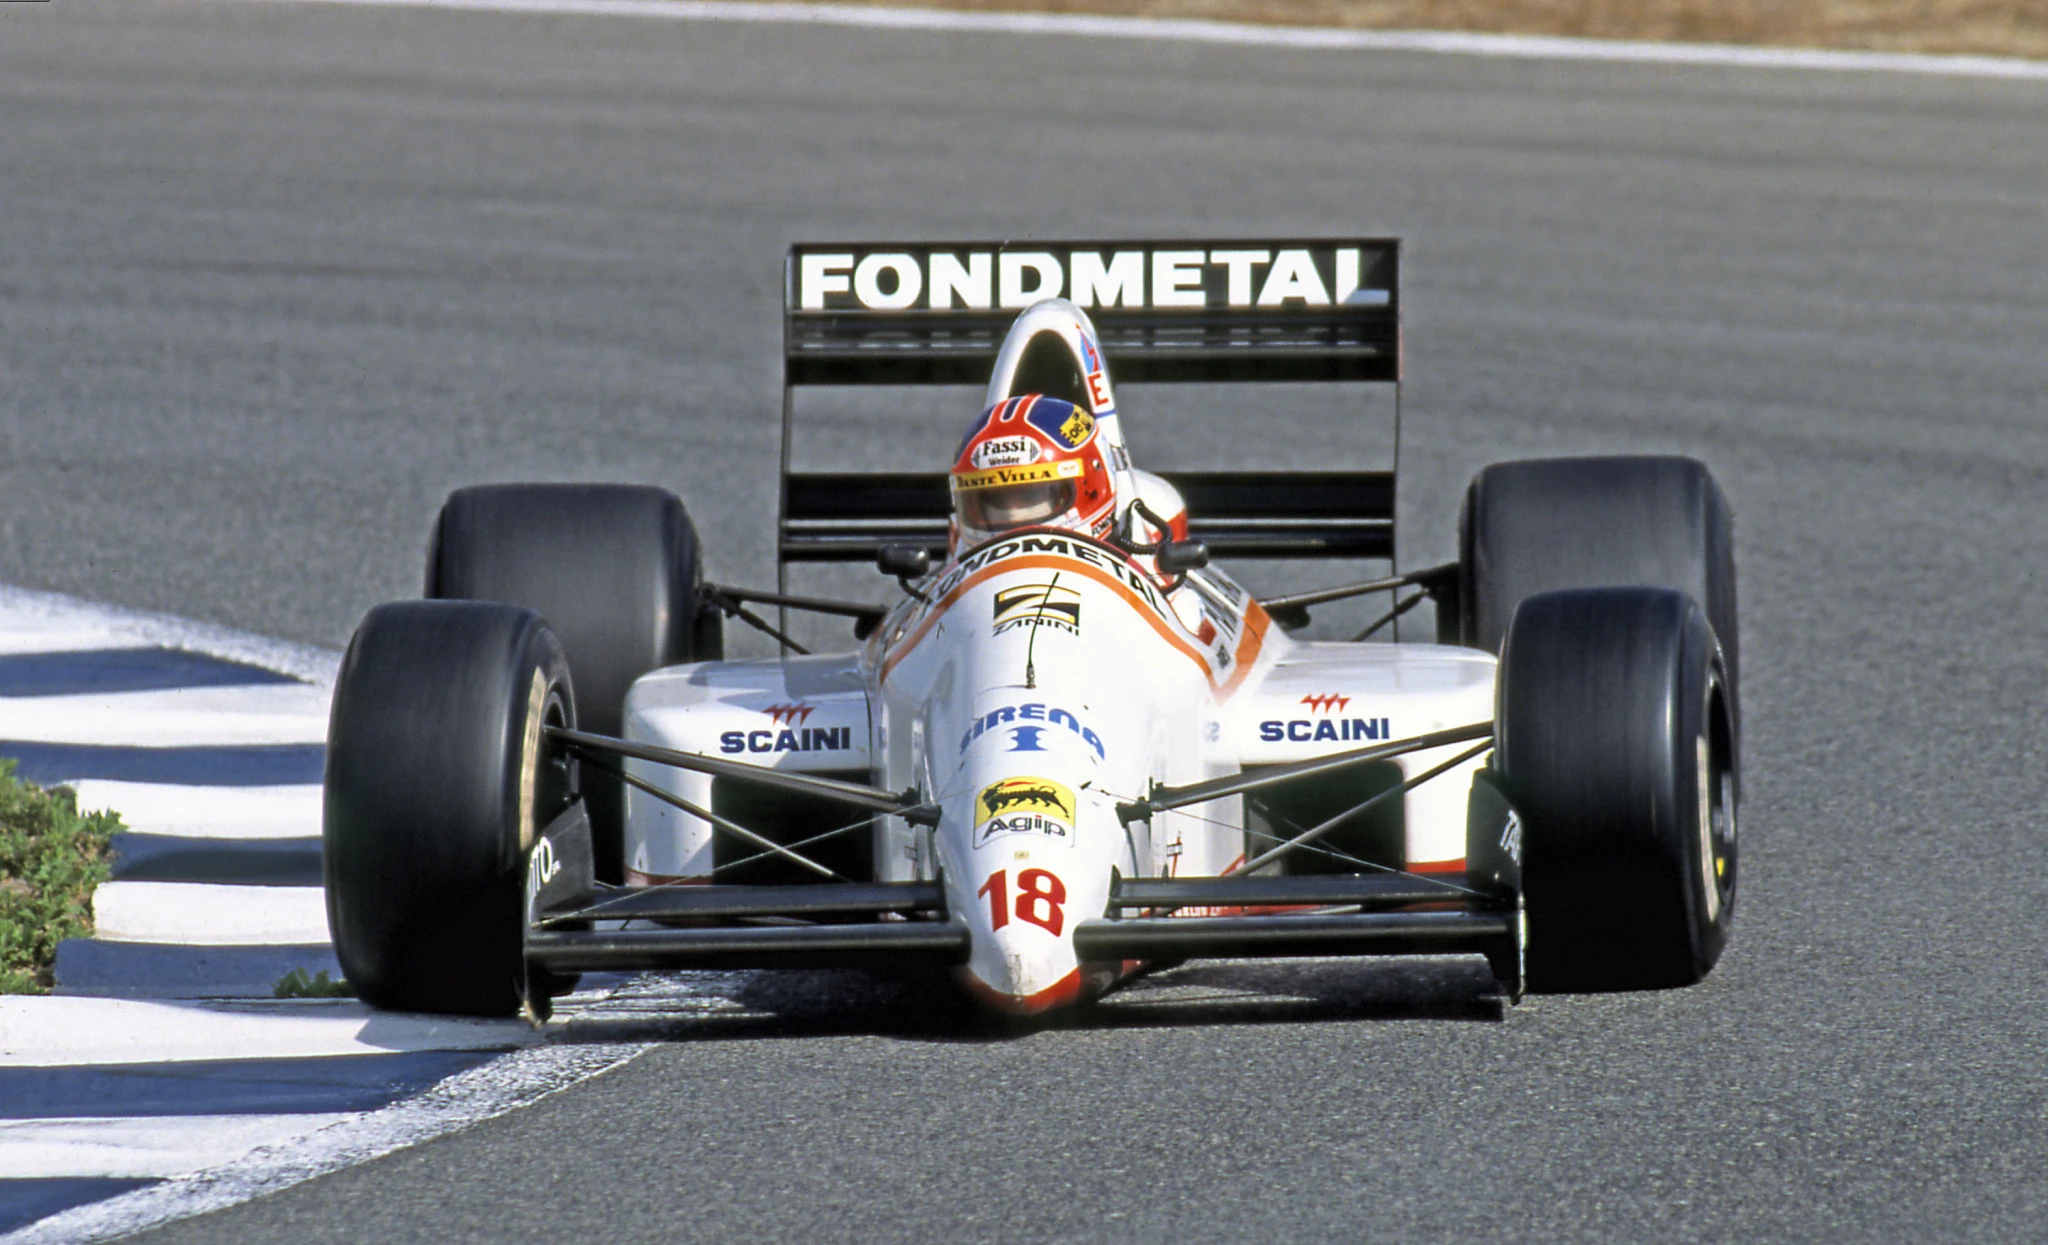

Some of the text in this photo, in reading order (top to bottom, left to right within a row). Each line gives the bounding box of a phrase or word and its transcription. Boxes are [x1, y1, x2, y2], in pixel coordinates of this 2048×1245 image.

[800, 249, 1389, 310] FONDMETAL
[983, 436, 1026, 456] Fassi
[988, 456, 1020, 467] Weider
[998, 470, 1052, 483] VILLA
[720, 726, 851, 754] SCAINI
[1259, 717, 1390, 742] SCAINI
[982, 815, 1066, 840] Agip
[977, 867, 1067, 938] 18
